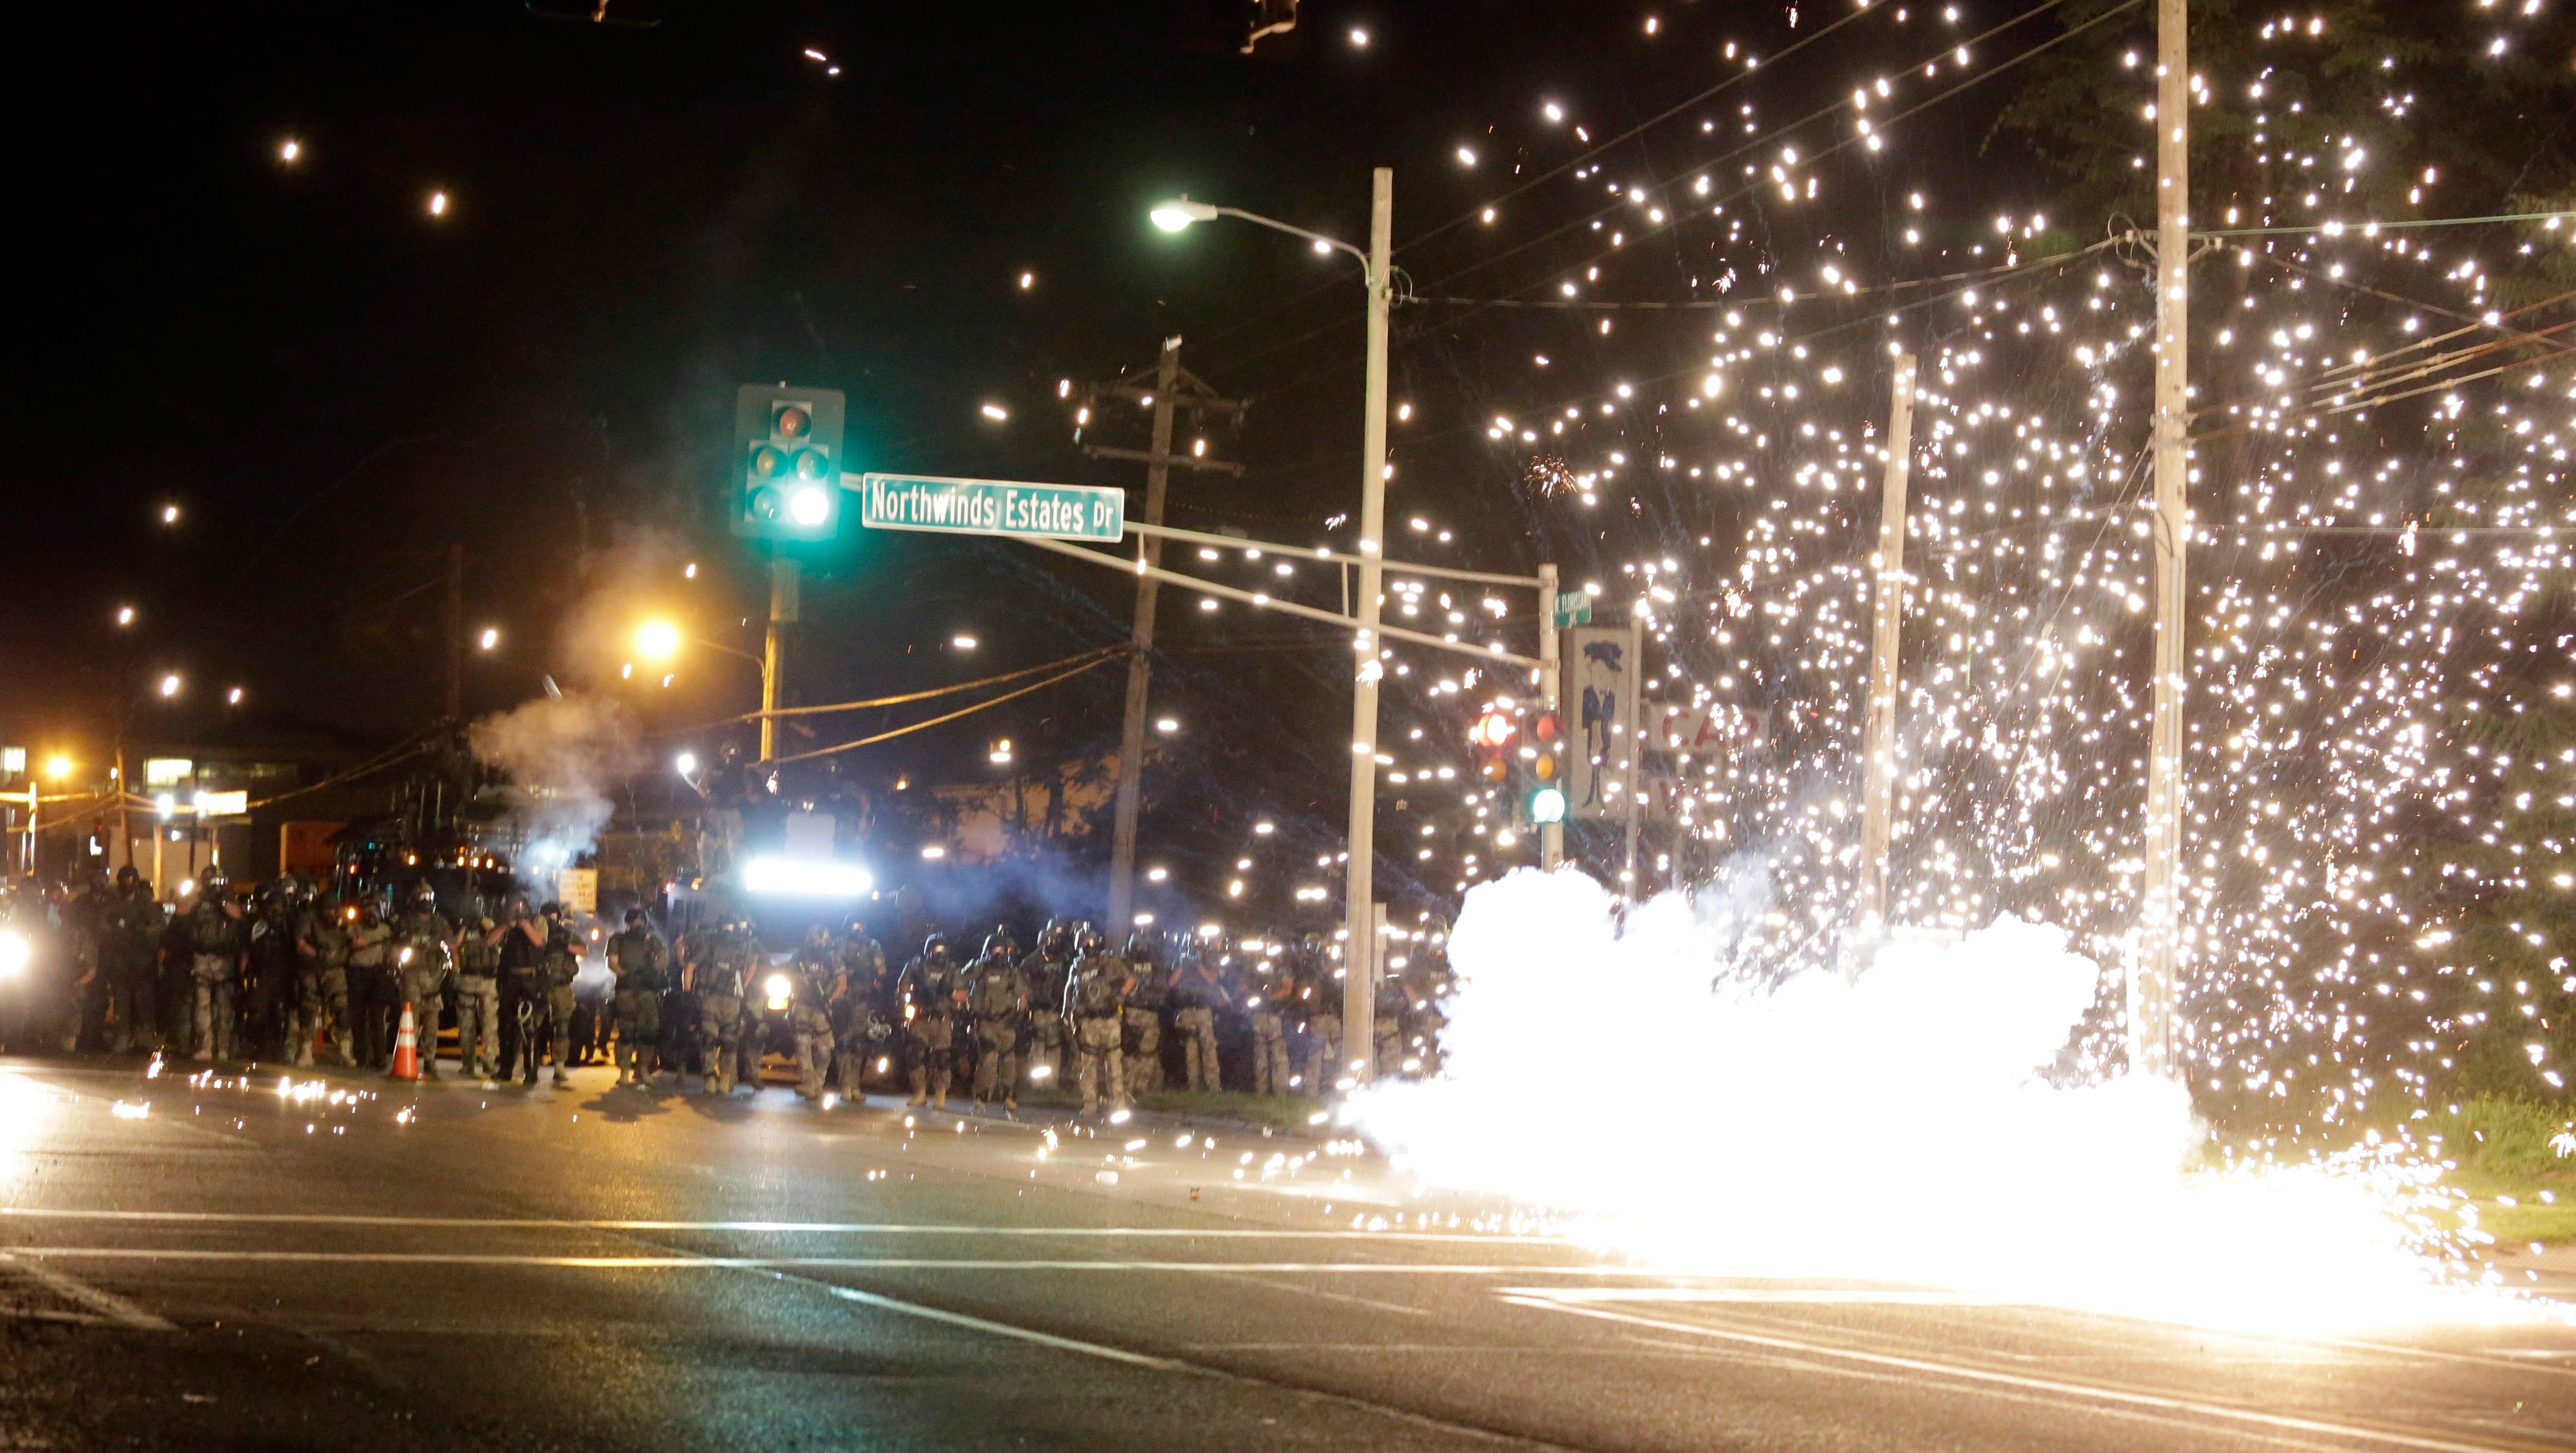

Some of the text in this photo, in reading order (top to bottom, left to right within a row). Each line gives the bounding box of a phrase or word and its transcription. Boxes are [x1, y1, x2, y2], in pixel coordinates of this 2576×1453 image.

[872, 480, 1114, 533] Northwinds Estates Dr
